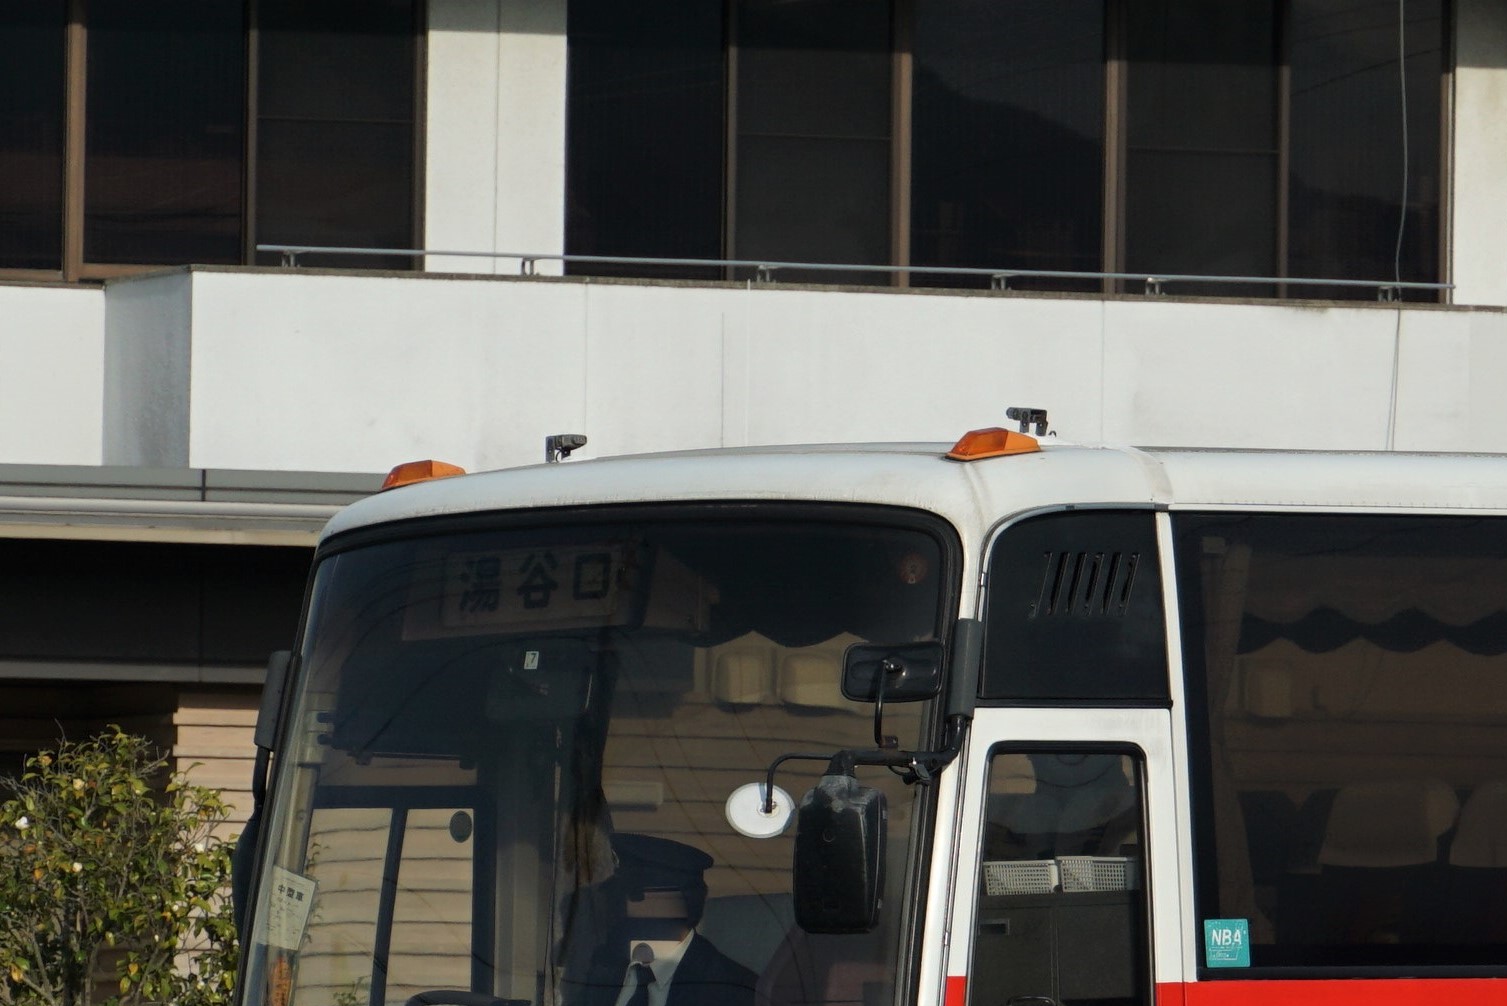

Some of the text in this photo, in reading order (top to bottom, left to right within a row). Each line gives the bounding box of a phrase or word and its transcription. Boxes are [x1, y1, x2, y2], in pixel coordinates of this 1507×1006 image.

[459, 553, 611, 612] 湯谷口
[1211, 928, 1242, 946] NBA
